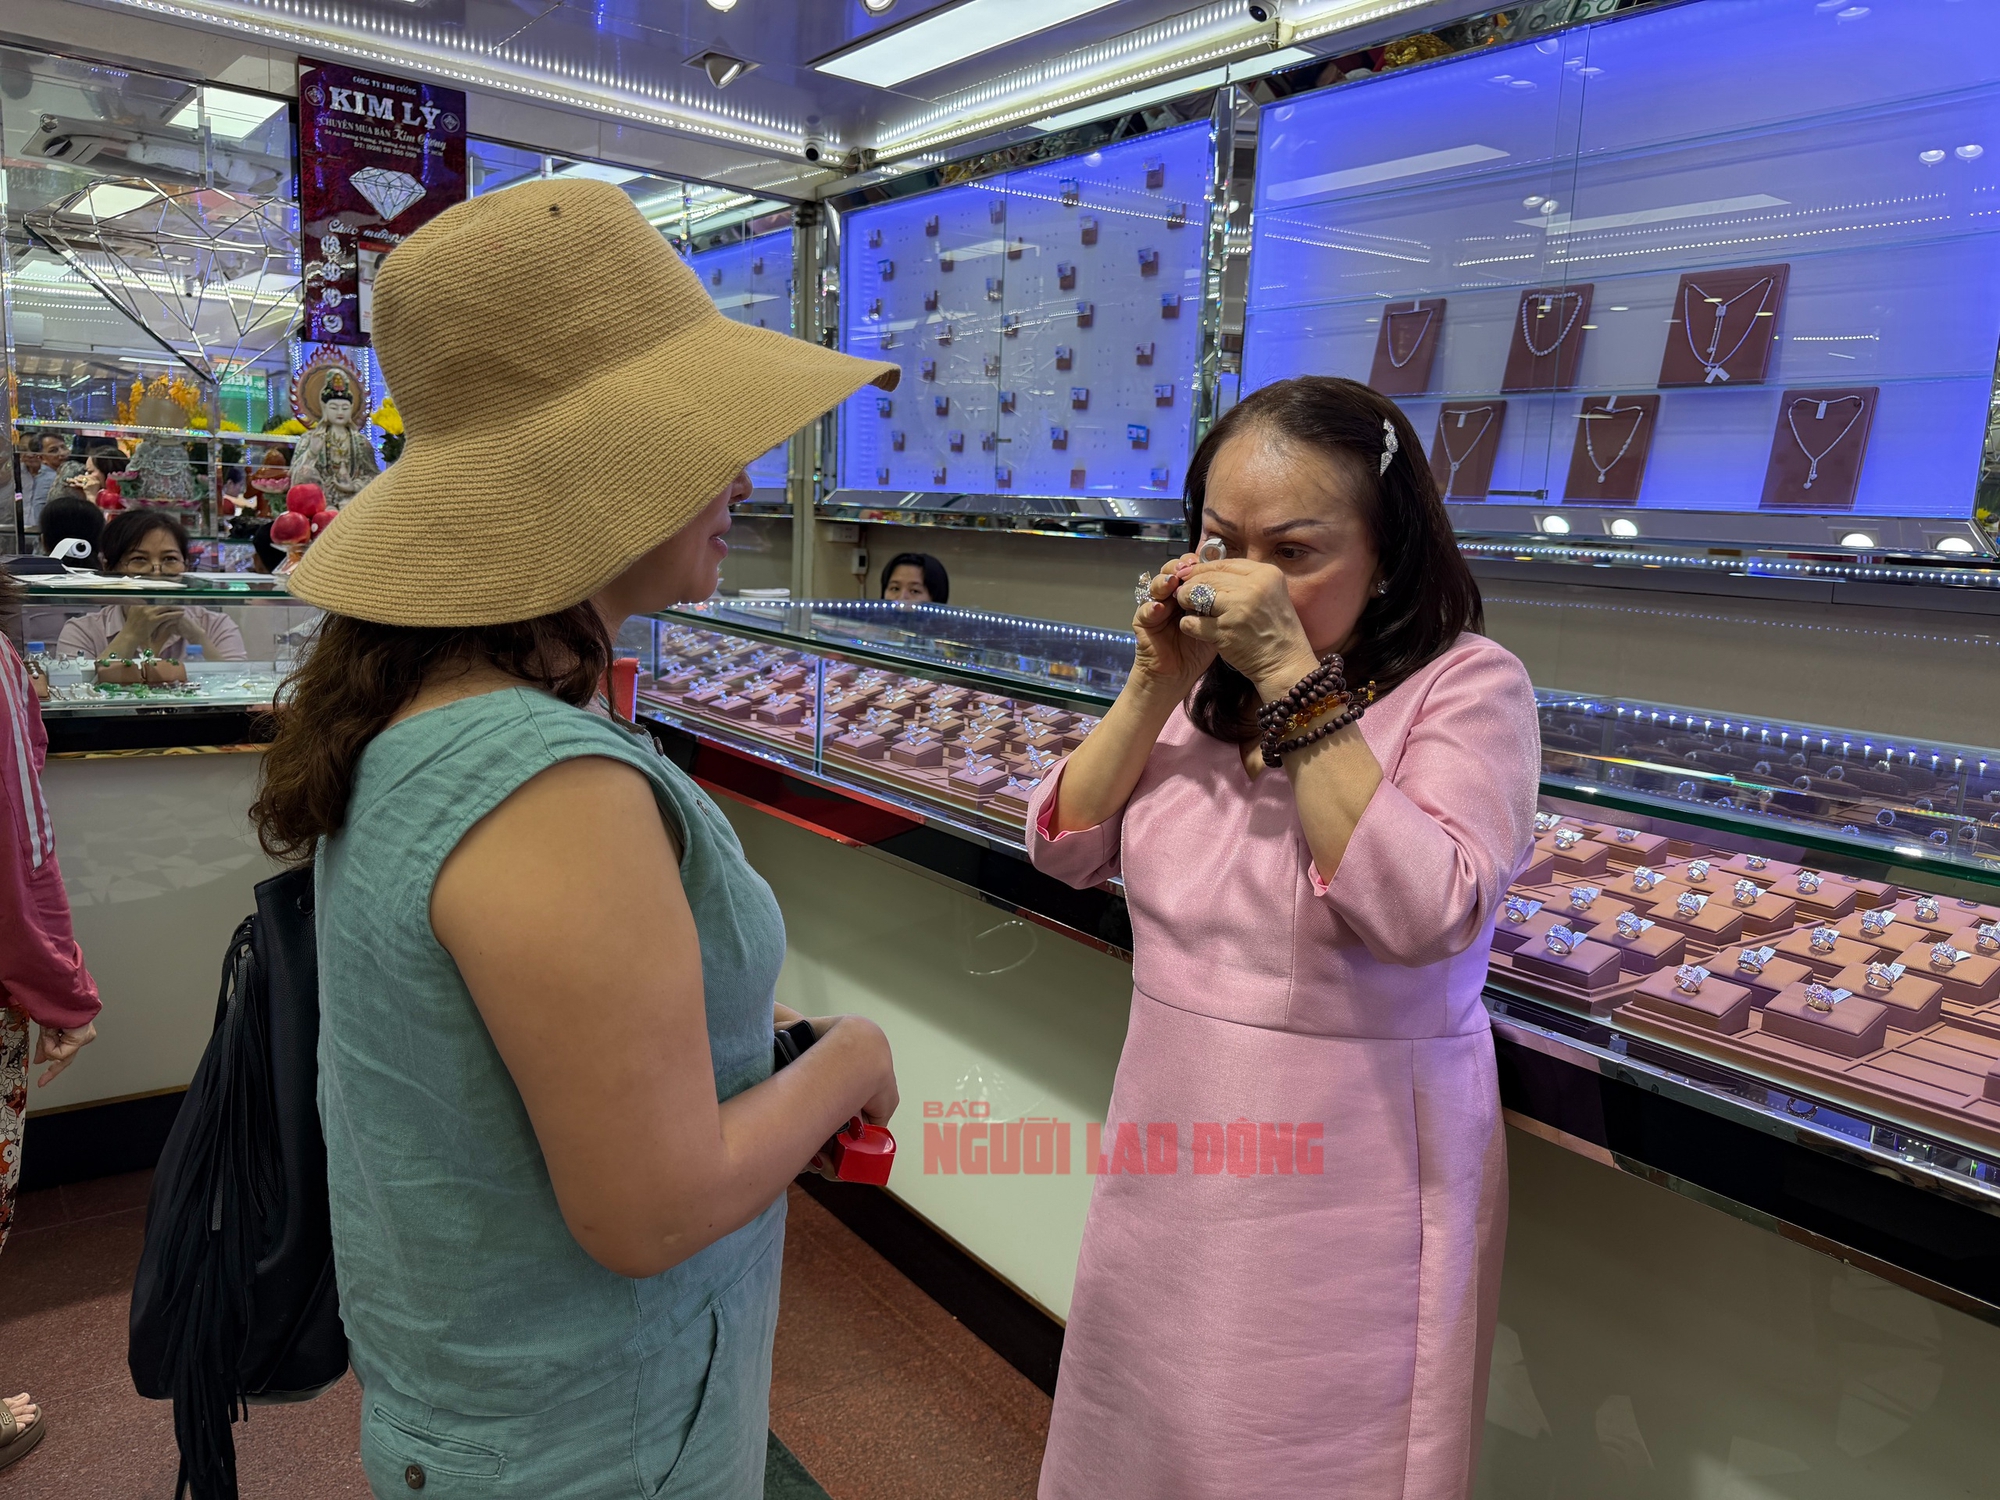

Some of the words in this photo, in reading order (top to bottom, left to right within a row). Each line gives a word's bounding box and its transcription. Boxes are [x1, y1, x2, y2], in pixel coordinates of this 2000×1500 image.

[328, 86, 394, 120] KIM
[402, 100, 441, 130] LÝ
[320, 116, 354, 130] CHUYÊN
[355, 123, 373, 134] MUA
[374, 126, 391, 138] BÁN
[392, 129, 416, 143] Kim
[328, 219, 359, 235] Chúc
